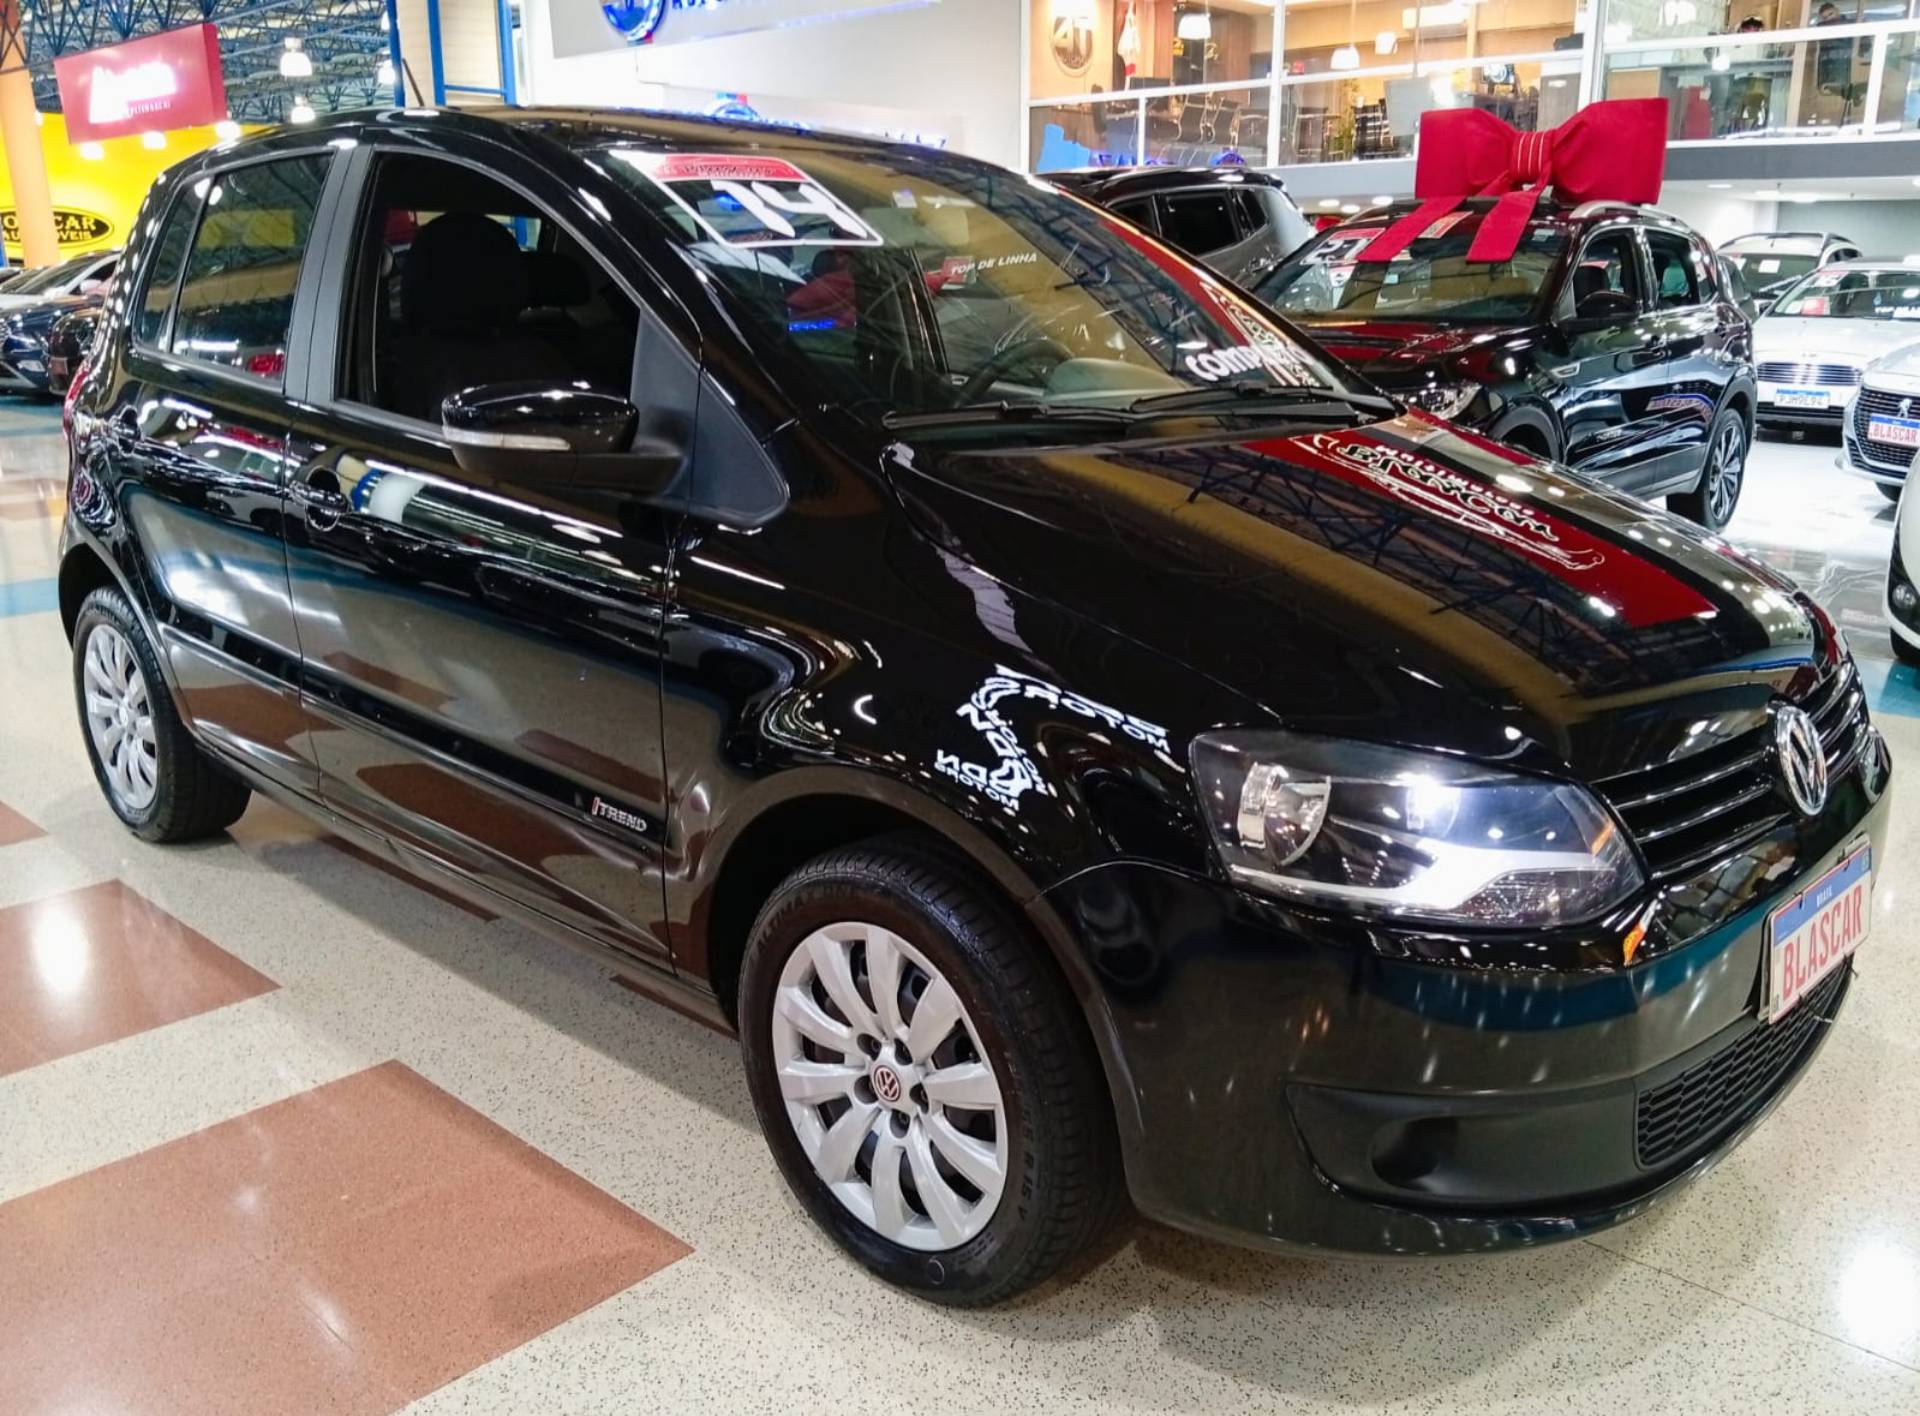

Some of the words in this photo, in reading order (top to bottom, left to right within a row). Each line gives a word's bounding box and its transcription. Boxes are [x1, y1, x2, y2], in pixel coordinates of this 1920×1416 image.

[710, 179, 869, 239] 14
[951, 262, 976, 275] TOP
[977, 258, 996, 270] DE
[998, 252, 1038, 266] LINHA
[1873, 424, 1918, 443] BLASCAR
[1783, 885, 1862, 1001] BLASCAR
